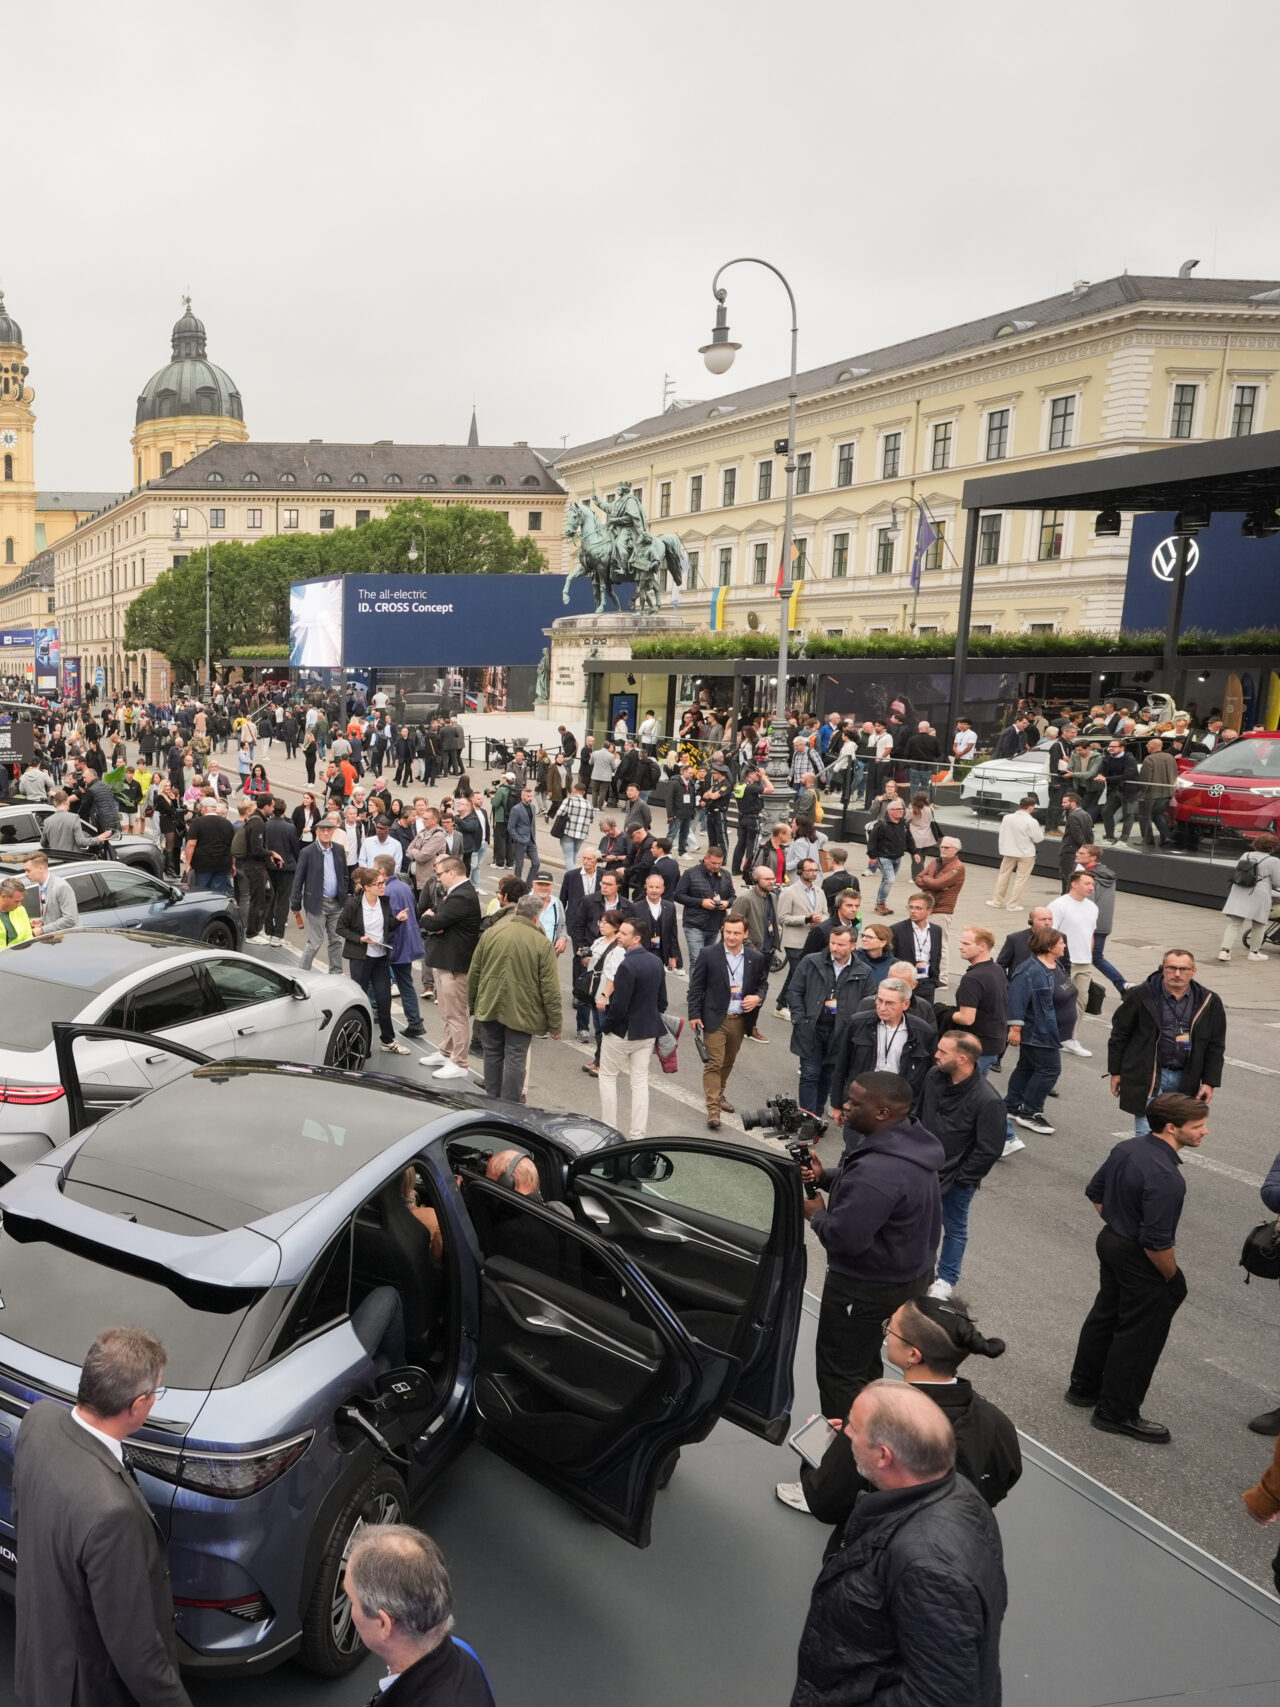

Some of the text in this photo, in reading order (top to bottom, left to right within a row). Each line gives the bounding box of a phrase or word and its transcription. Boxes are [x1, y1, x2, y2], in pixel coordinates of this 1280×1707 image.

[358, 588, 428, 599] The all-electric
[358, 602, 454, 615] ID. CROSS Concept
